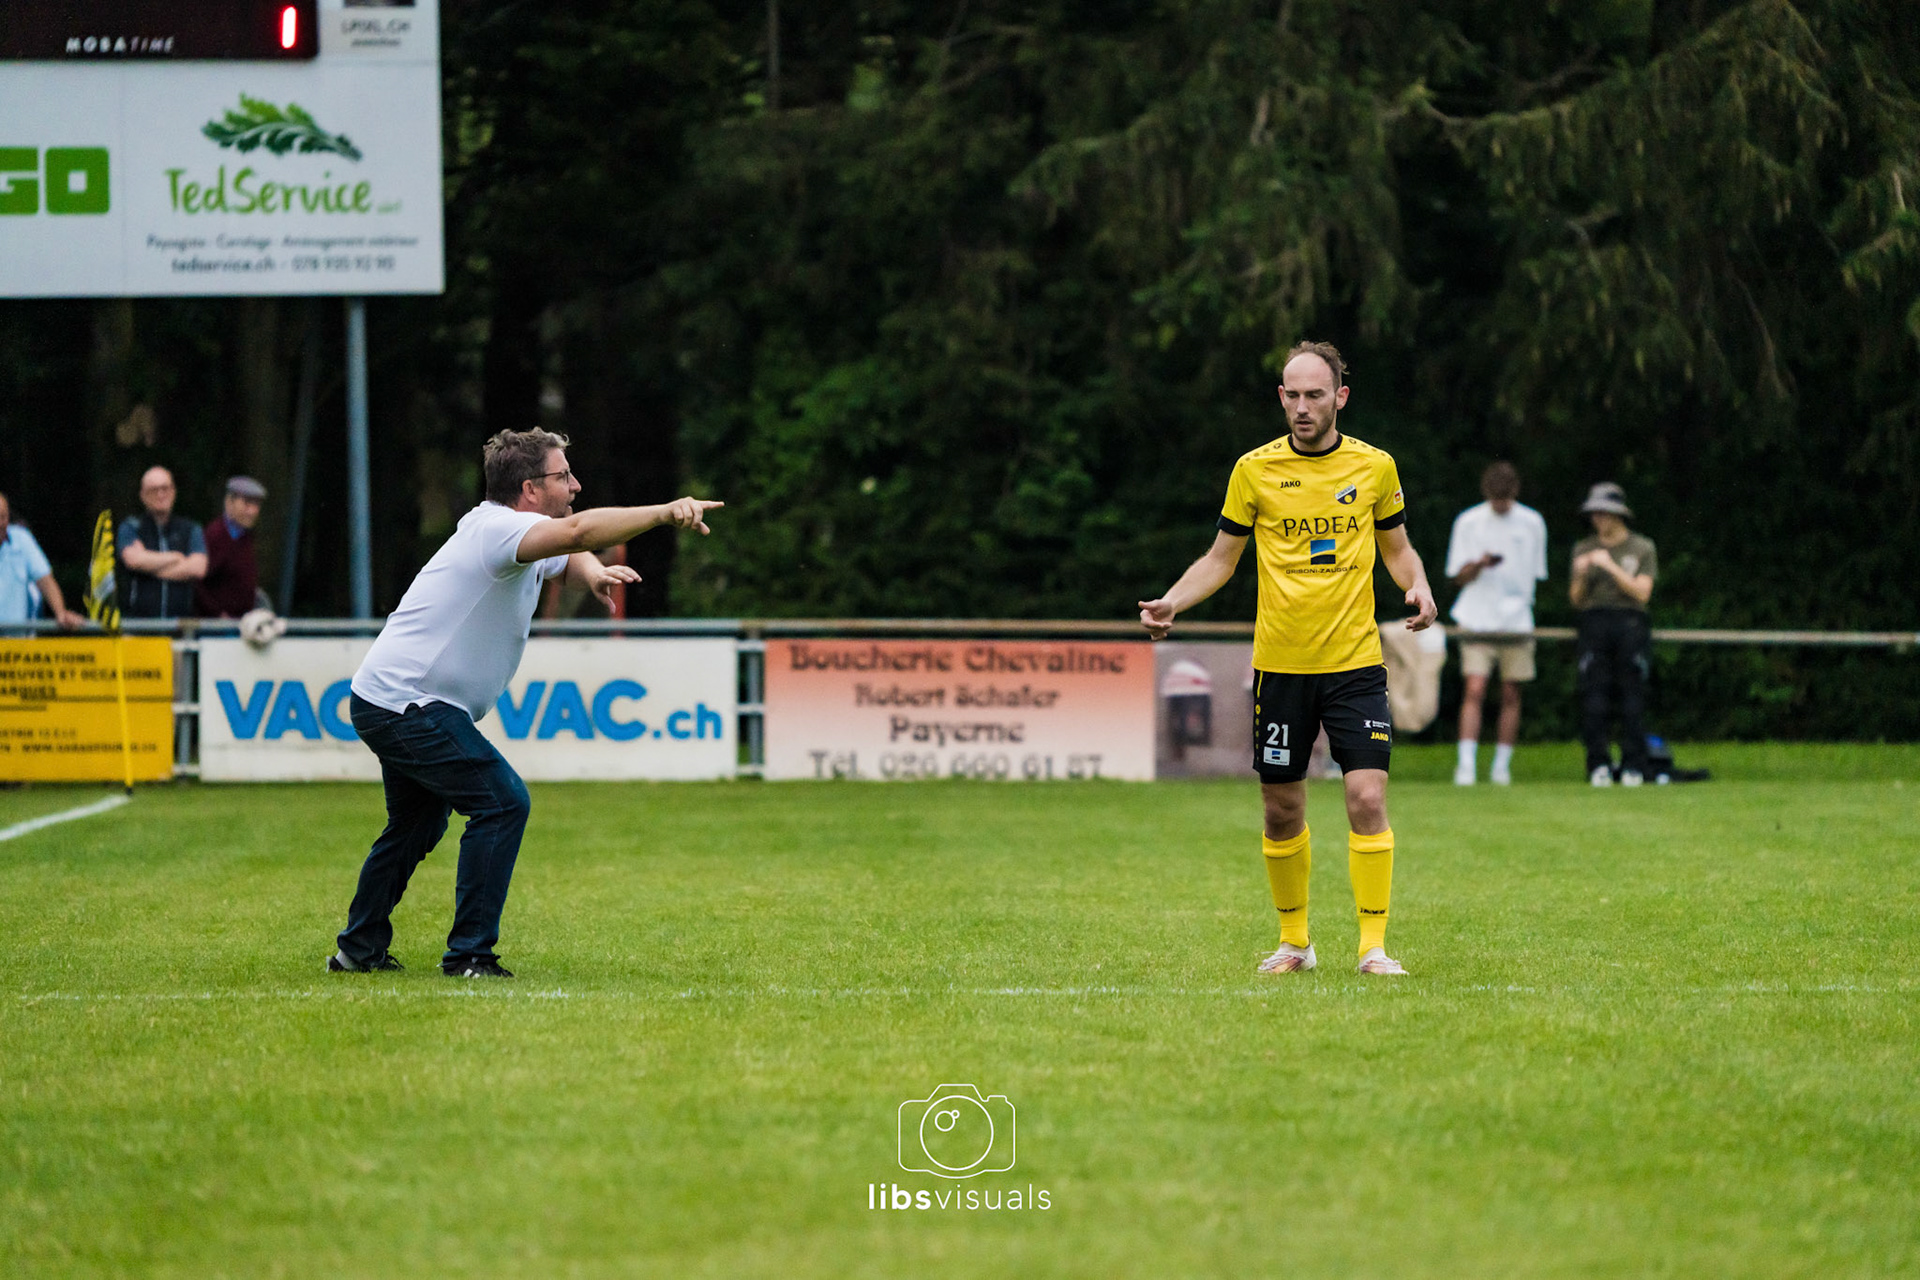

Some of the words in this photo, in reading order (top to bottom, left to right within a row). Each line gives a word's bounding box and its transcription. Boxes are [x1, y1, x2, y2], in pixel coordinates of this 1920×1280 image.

[282, 6, 297, 48] 1
[66, 36, 175, 53] MOBATIME
[164, 164, 371, 214] TedService
[1279, 480, 1301, 489] JAKO
[1282, 515, 1359, 537] PADEA
[0, 651, 95, 664] ÉPARATIONS
[788, 644, 953, 673] Boucherie
[963, 645, 1127, 674] Chevaline
[81, 669, 161, 681] OCCAIONS
[855, 683, 945, 708] Robert
[496, 678, 722, 742] VAC.ch
[889, 715, 1025, 747] Payerne
[1266, 722, 1289, 747] 21
